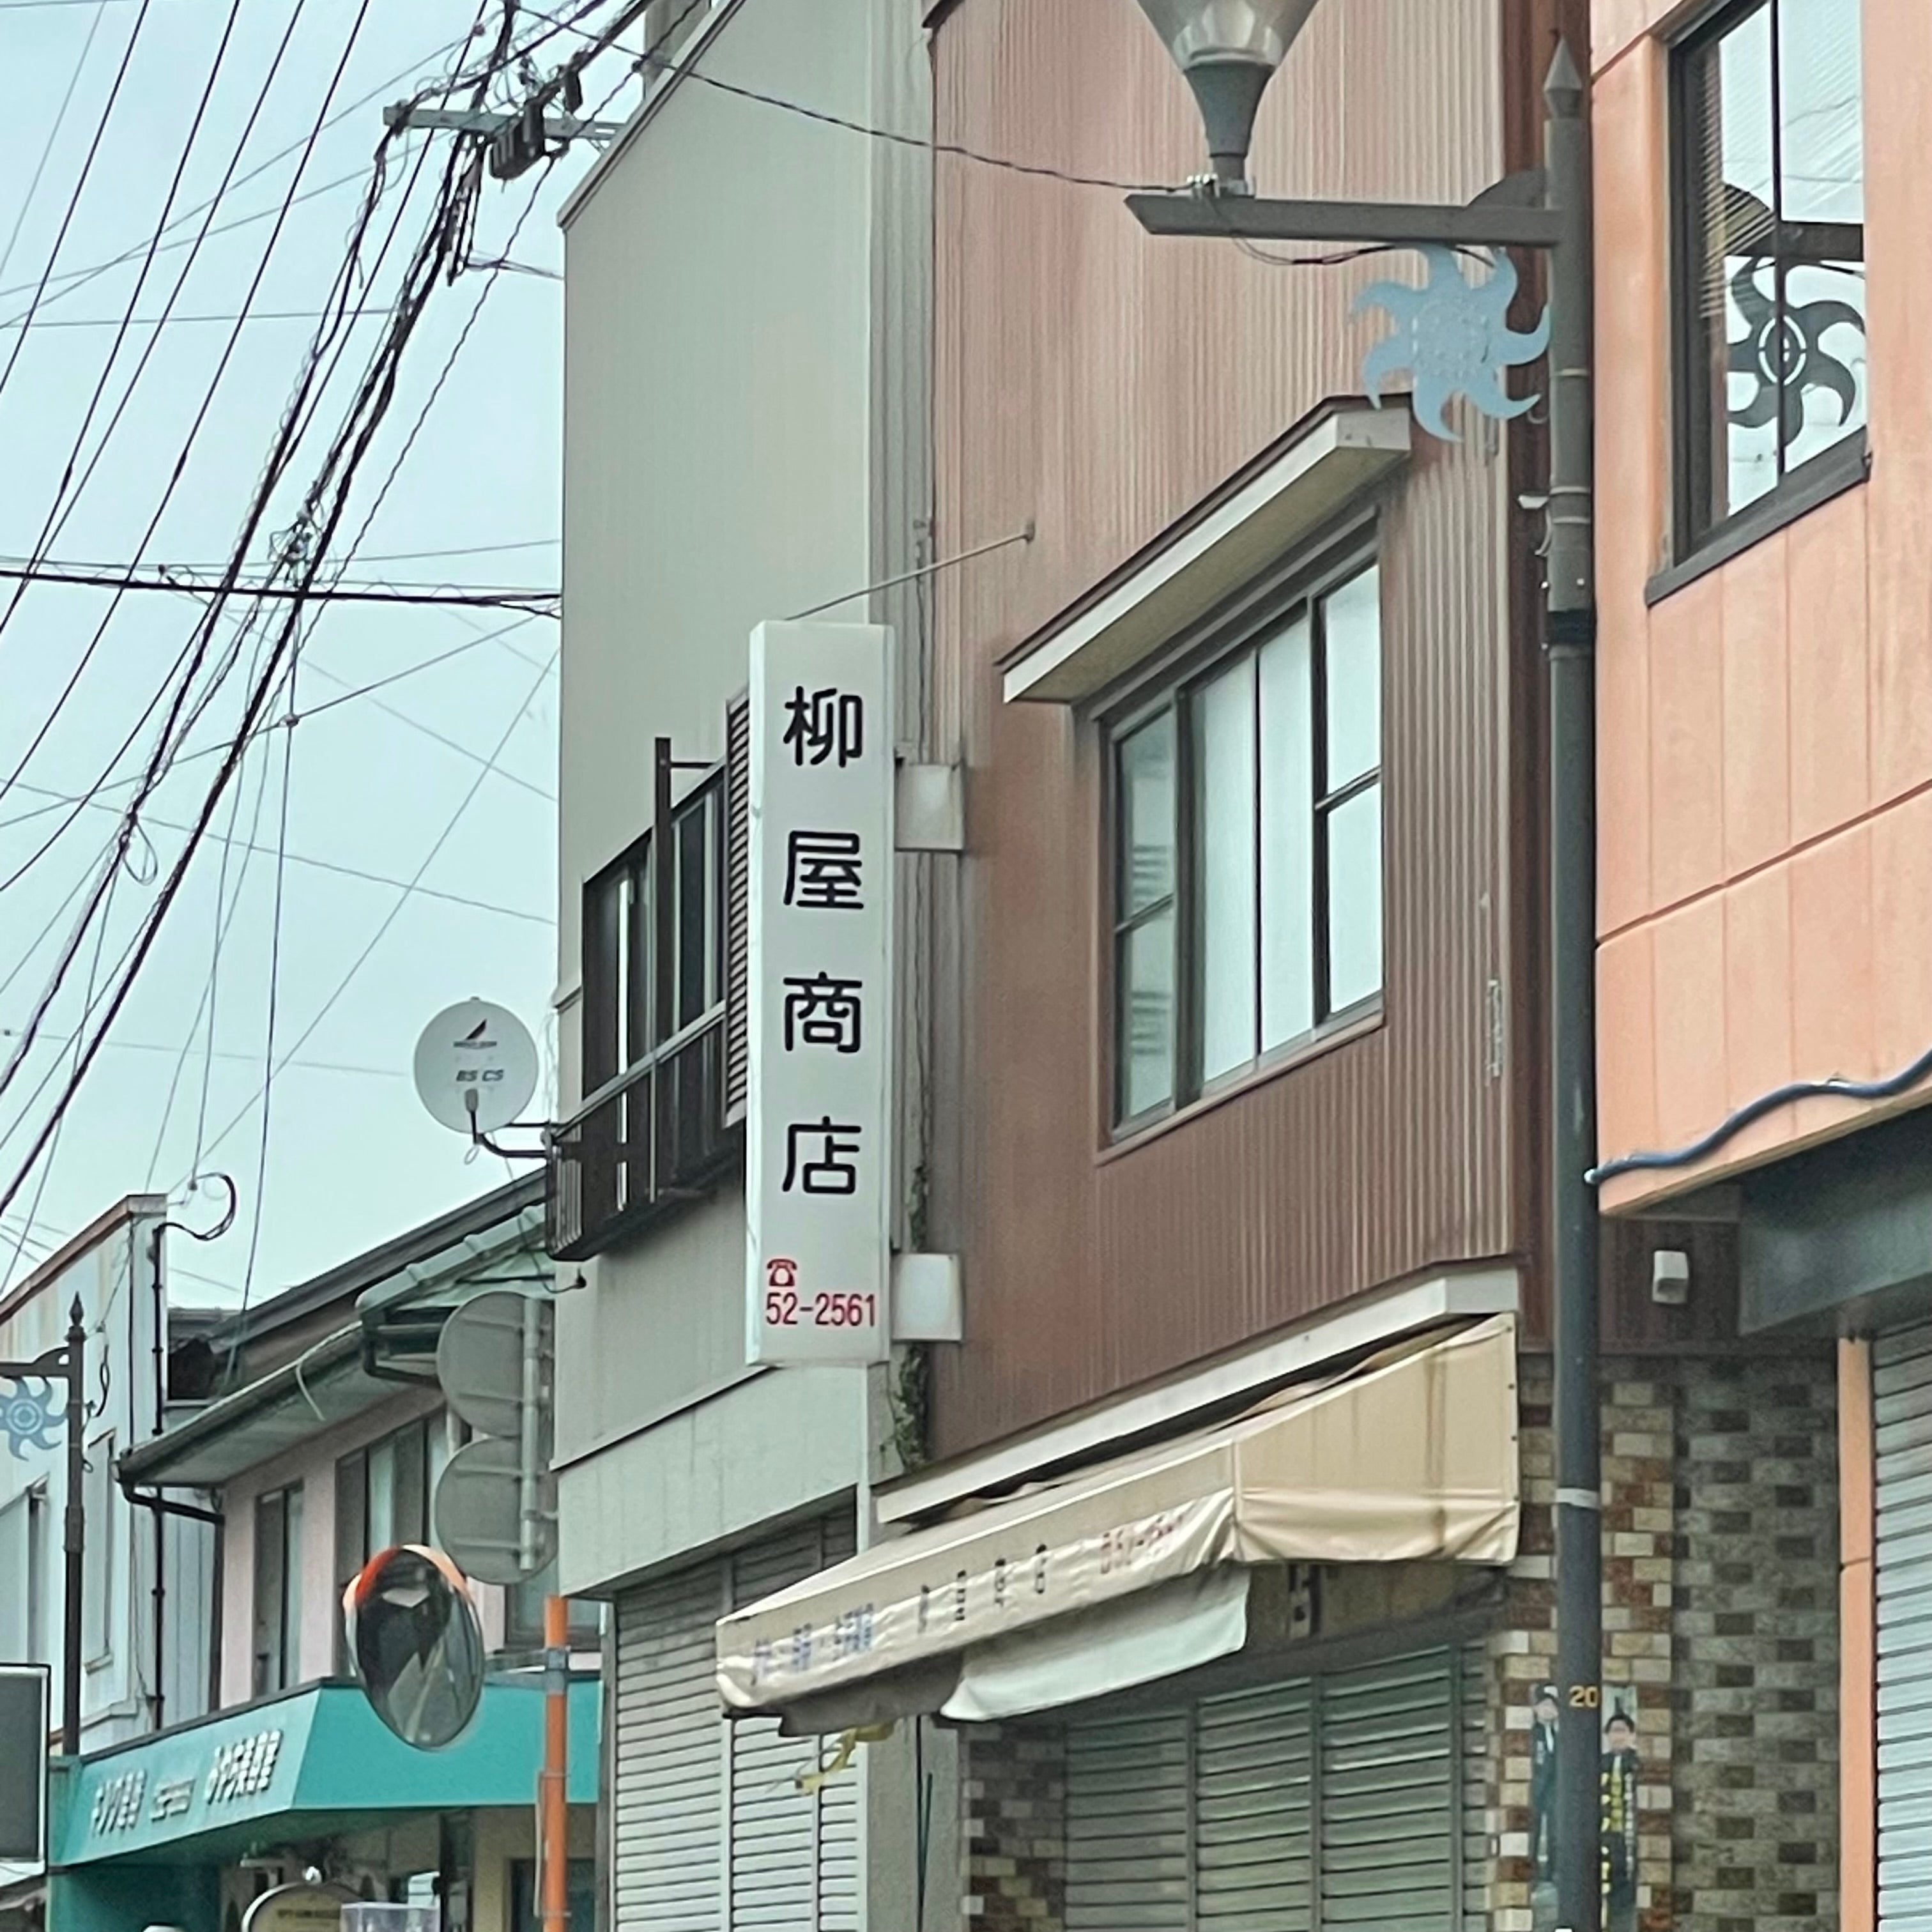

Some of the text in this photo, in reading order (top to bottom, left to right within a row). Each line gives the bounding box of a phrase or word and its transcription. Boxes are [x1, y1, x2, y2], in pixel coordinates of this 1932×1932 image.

[781, 685, 864, 1195] 柳屋商店
[482, 1069, 504, 1082] CS
[766, 1292, 875, 1327] 52-2561
[1569, 1685, 1598, 1707] 20
